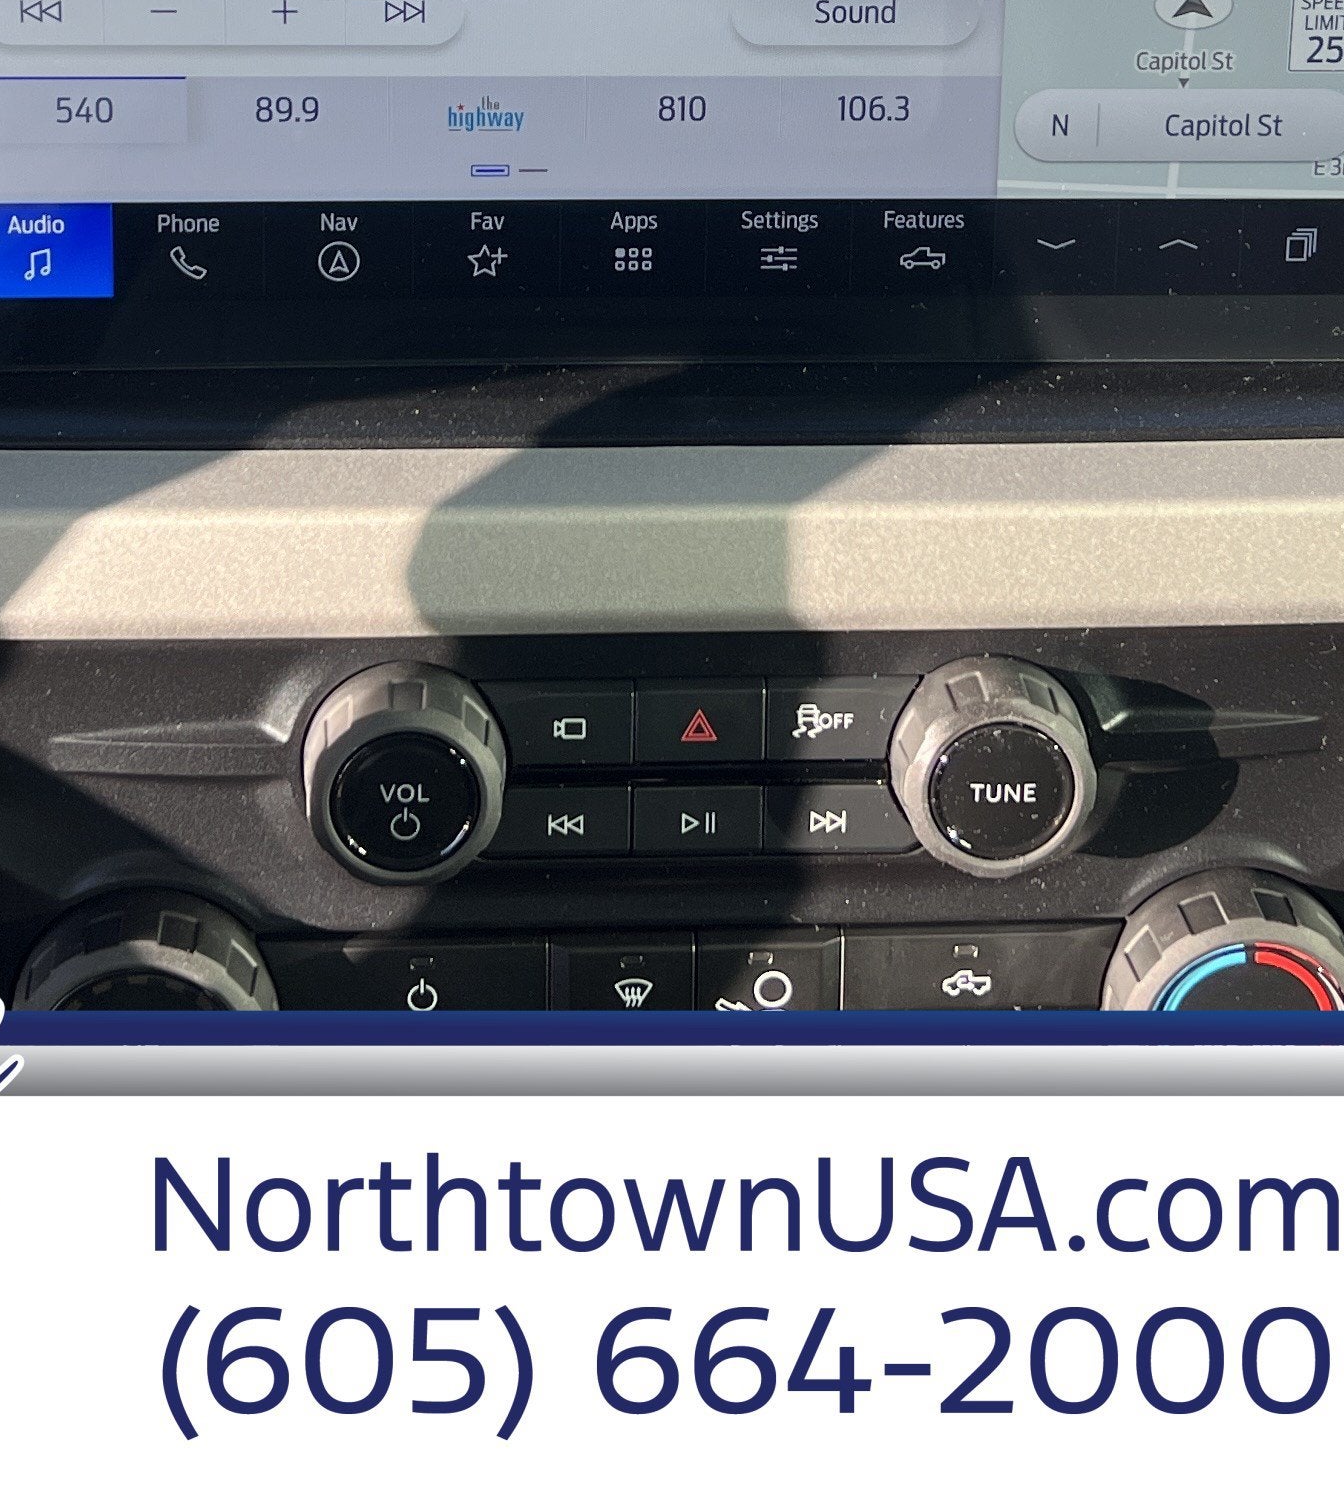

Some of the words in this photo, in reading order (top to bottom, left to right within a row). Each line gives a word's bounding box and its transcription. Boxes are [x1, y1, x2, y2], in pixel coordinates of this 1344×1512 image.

[814, 0, 897, 25] Sound
[1306, 36, 1344, 64] 25
[1136, 51, 1206, 73] Capitol
[1210, 51, 1234, 71] St
[56, 96, 114, 123] 540
[255, 96, 320, 123] 89.9
[481, 95, 500, 110] the
[658, 95, 706, 122] 810
[838, 95, 910, 122] 106.3
[448, 106, 524, 131] highway
[1051, 115, 1069, 137] N
[1165, 114, 1250, 140] Capitol
[1257, 115, 1283, 137] St
[7, 214, 65, 235] Audio
[157, 213, 220, 234] Phone
[320, 212, 358, 232] Nav
[470, 211, 505, 232] Fav
[610, 211, 658, 234] Apps
[741, 210, 818, 233] Settings
[883, 211, 965, 230] Features
[819, 712, 855, 730] OFF
[380, 783, 430, 804] VOL
[970, 783, 1036, 804] TUNE
